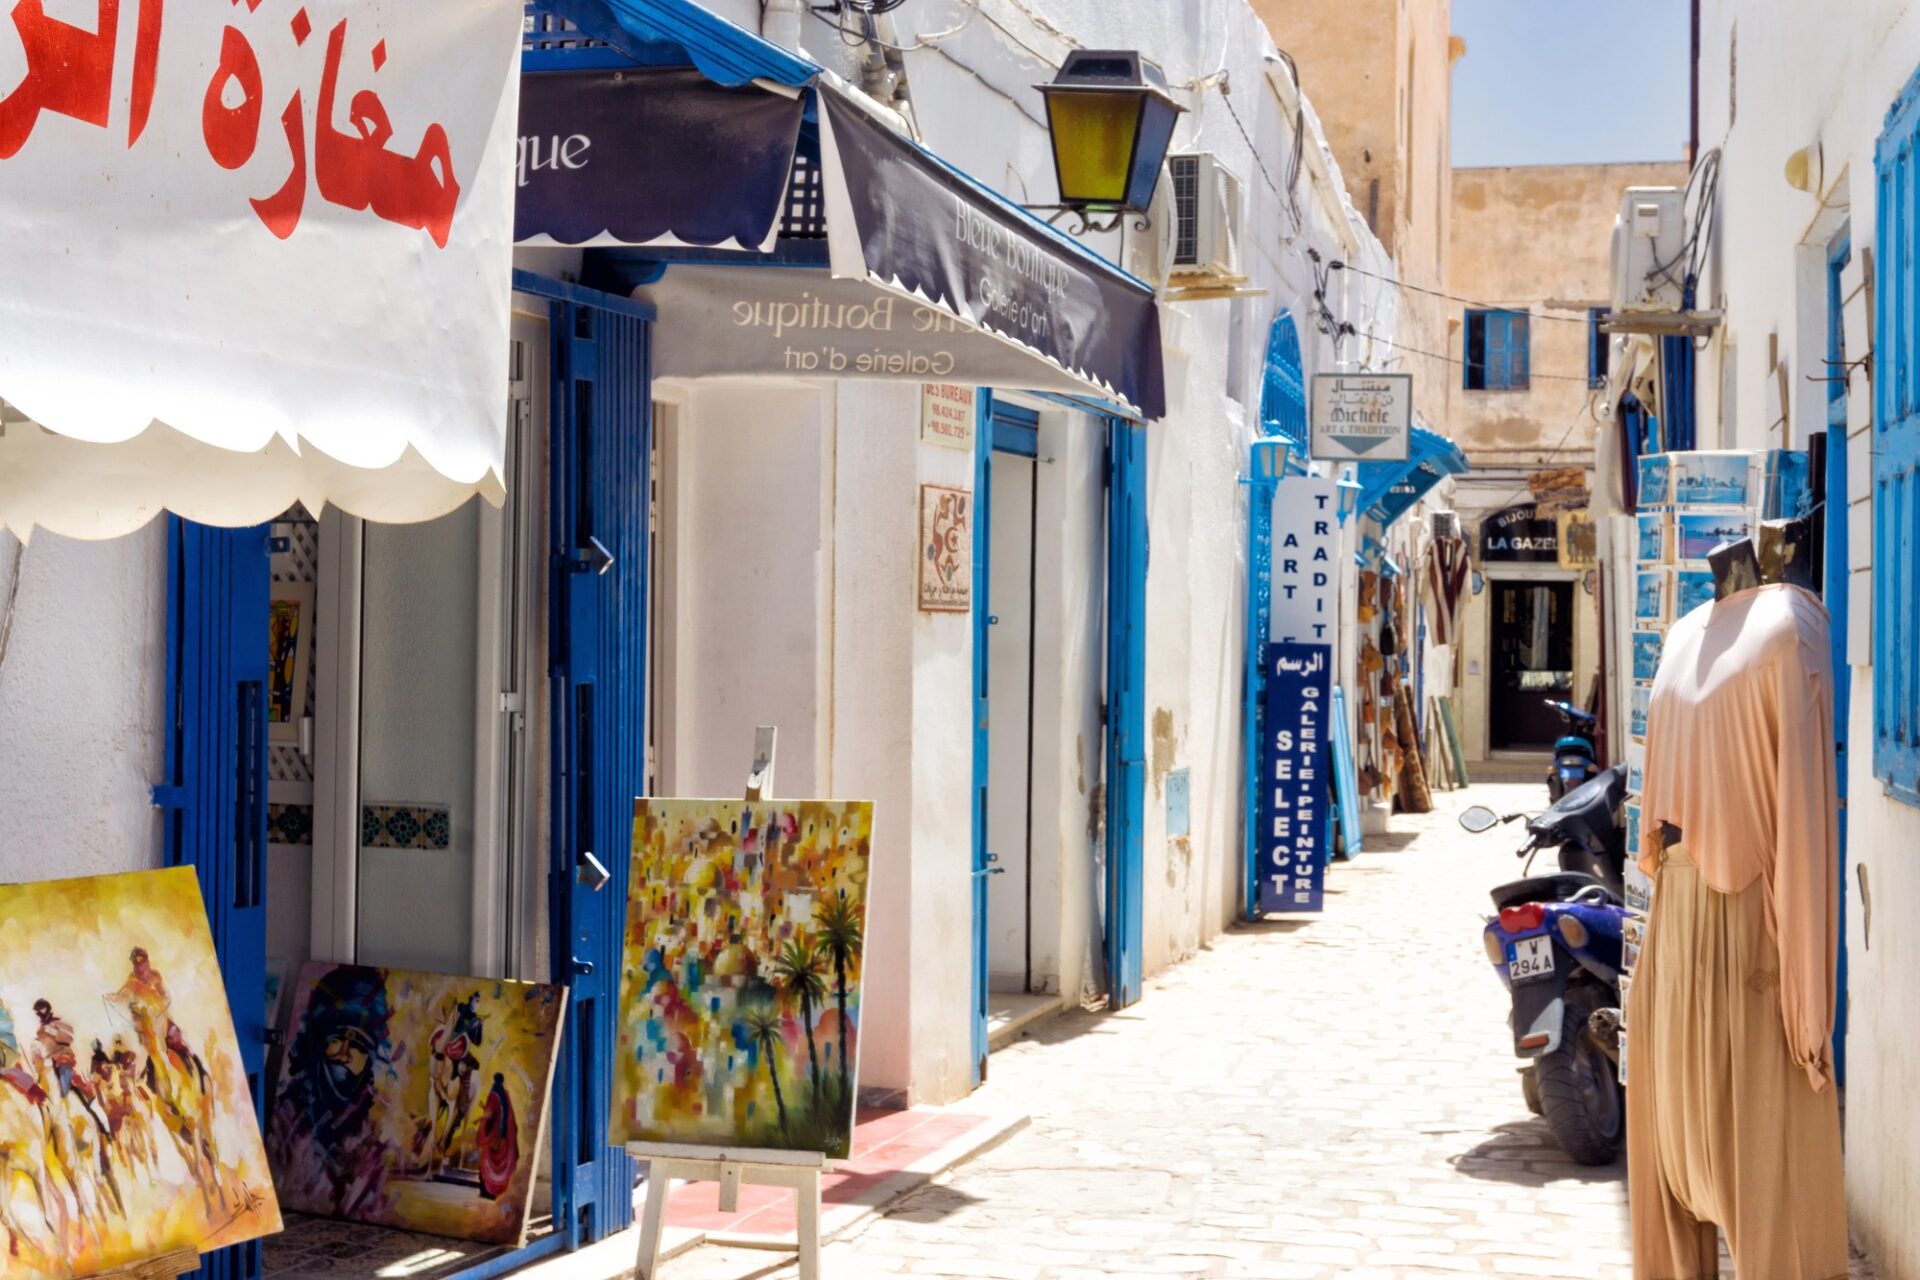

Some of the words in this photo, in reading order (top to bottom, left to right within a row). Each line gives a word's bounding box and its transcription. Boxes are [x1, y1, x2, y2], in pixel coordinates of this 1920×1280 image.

[516, 133, 592, 187] que
[955, 198, 1001, 260] Bleue
[1006, 227, 1070, 304] Boutique
[979, 277, 1018, 323] Galerie
[1497, 509, 1537, 528] BIJOU
[1488, 537, 1508, 550] LA
[1511, 537, 1557, 550] GAZEL
[1283, 533, 1298, 599] ART
[1276, 651, 1324, 677] الرسم
[1271, 730, 1293, 895] SELECT
[1529, 940, 1538, 956] W
[1511, 957, 1540, 977] 294
